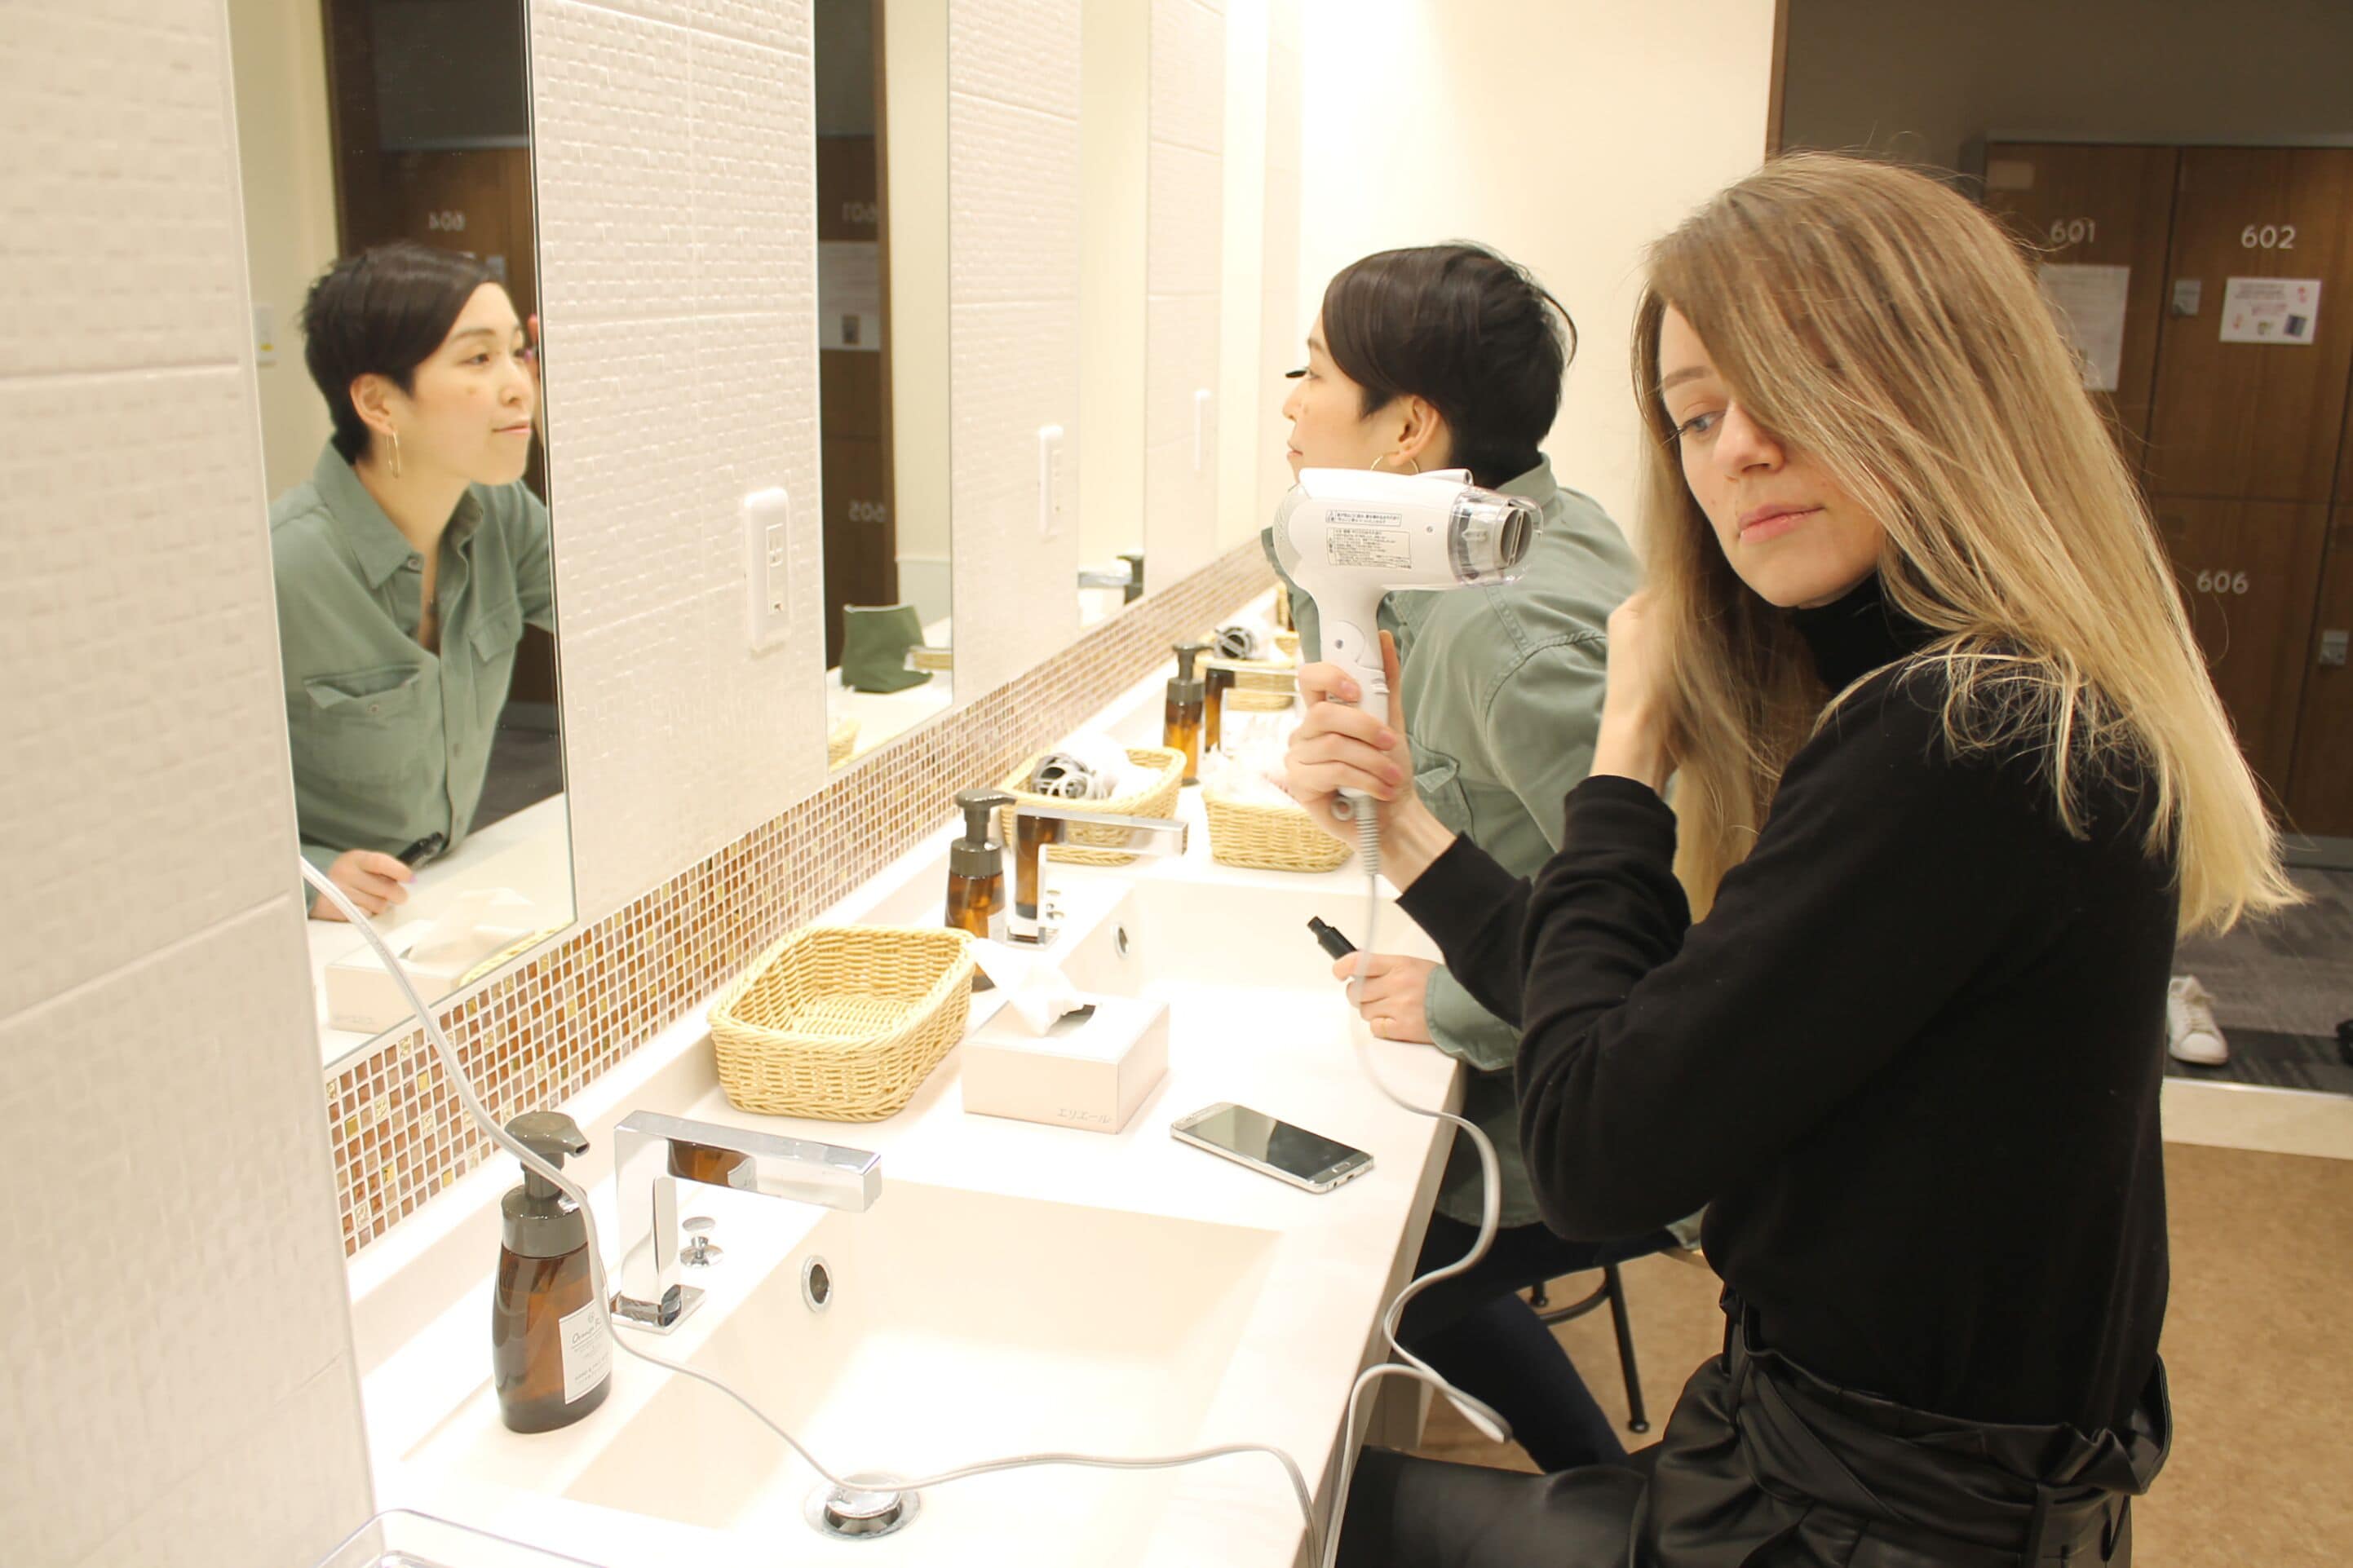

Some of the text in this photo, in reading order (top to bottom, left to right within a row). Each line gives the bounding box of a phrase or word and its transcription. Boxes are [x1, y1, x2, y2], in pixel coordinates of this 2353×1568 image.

[2050, 219, 2096, 243] 601
[2240, 224, 2296, 249] 602
[2196, 569, 2249, 594] 606
